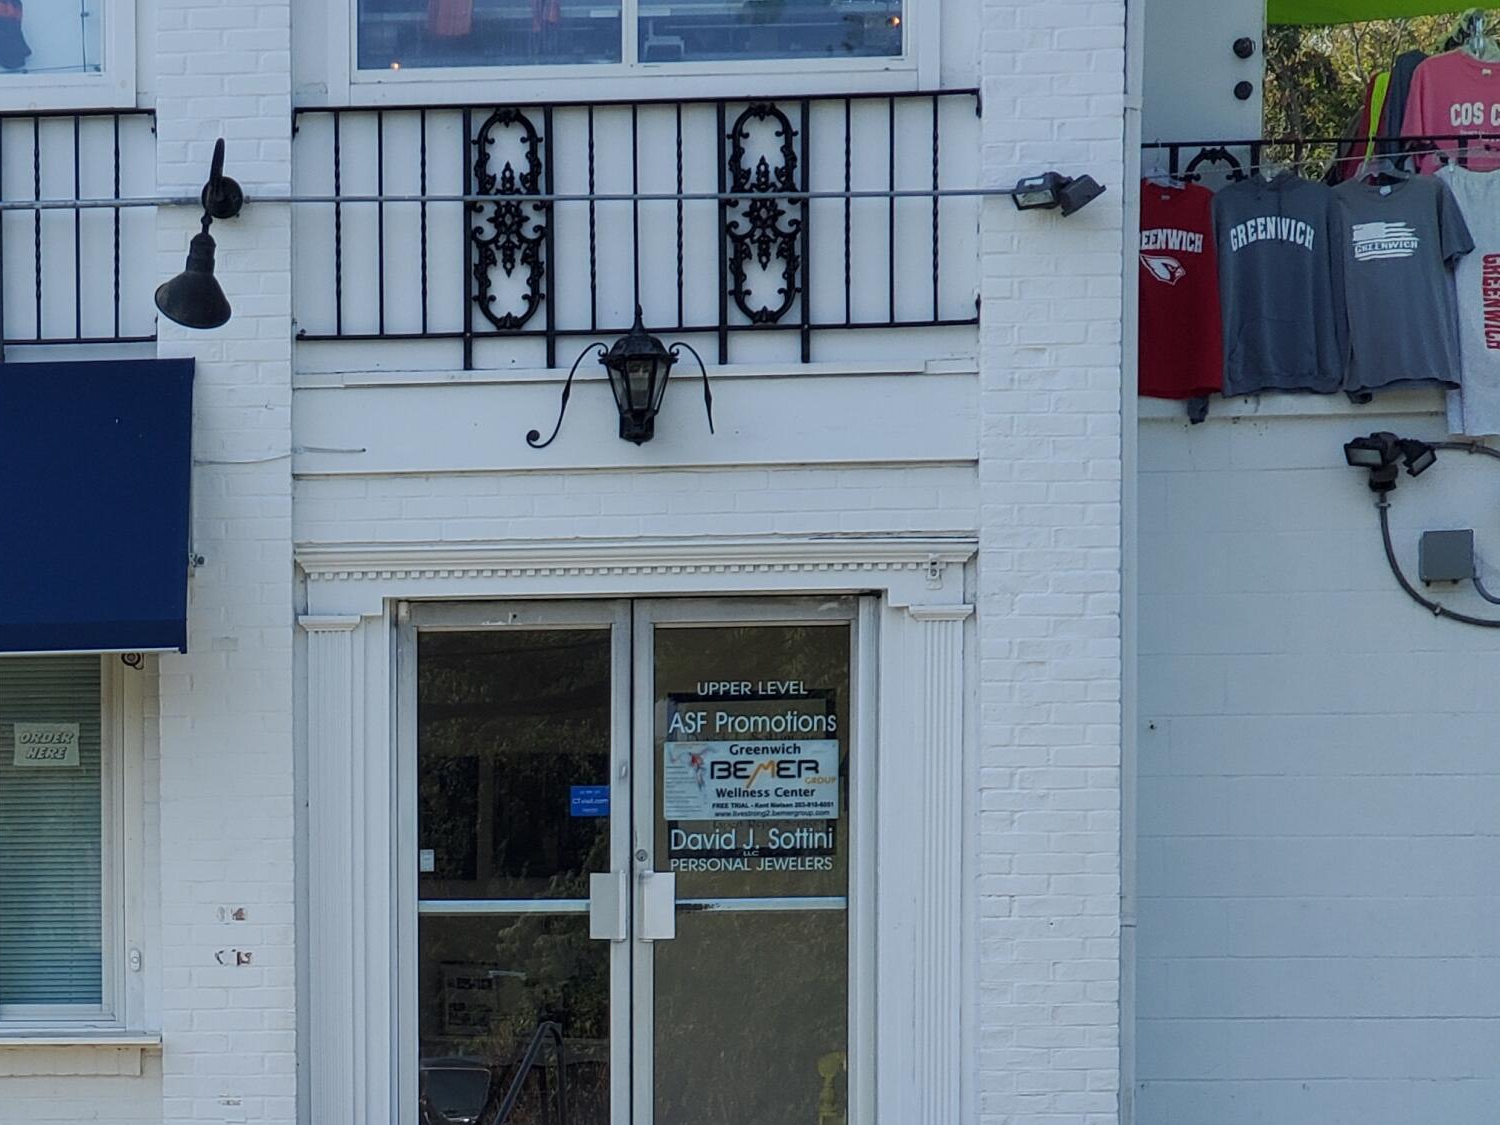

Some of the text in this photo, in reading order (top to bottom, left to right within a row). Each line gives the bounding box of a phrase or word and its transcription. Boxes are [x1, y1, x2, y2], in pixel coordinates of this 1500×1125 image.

[1450, 101, 1485, 127] COS
[1140, 228, 1204, 253] EENWICH
[1230, 215, 1315, 252] GREENWICH
[1354, 239, 1419, 254] GREENWICH
[697, 680, 809, 695] UPPER LEVEL
[668, 710, 837, 734] ASF Promotions
[19, 731, 75, 745] ORDER
[25, 746, 68, 760] HERE
[729, 743, 801, 755] Greenwich
[710, 759, 819, 788] BEMER
[804, 776, 836, 785] GROUP
[715, 787, 816, 798] Wellness Center
[670, 827, 833, 850] David J. Sottini
[670, 857, 833, 872] PERSONAL JEWELERS
